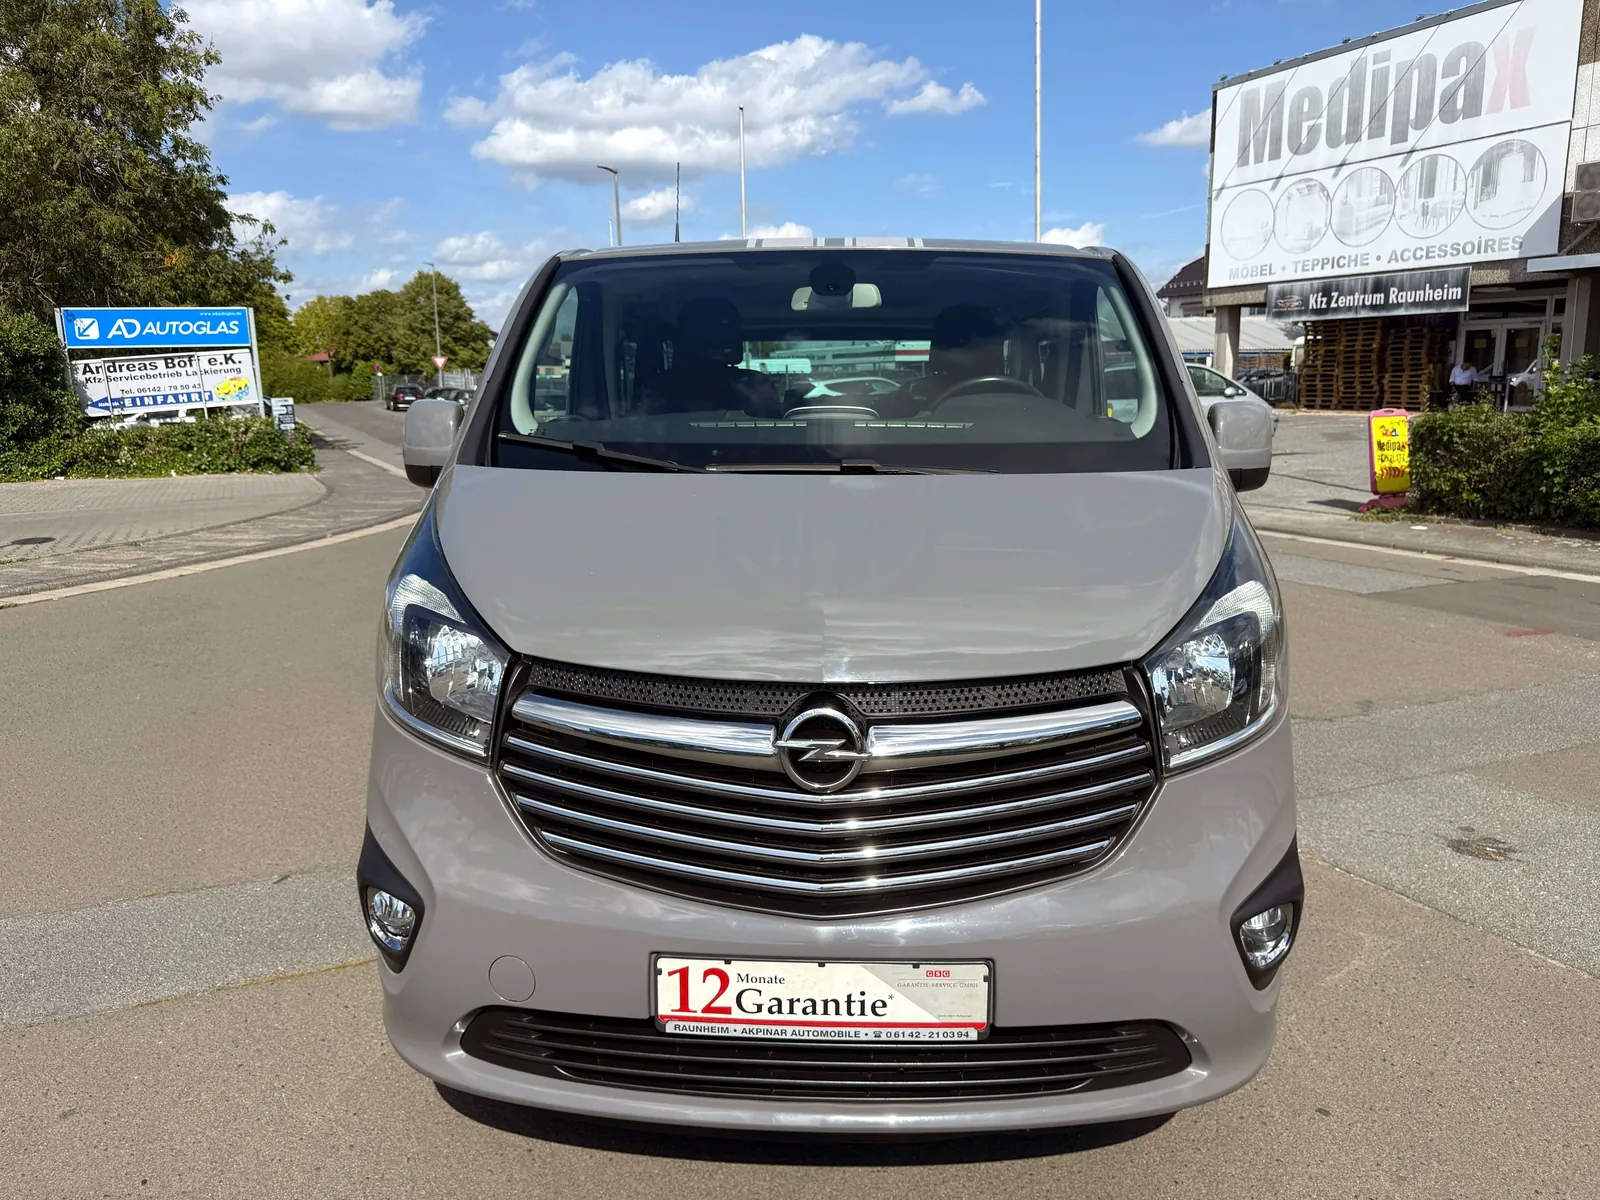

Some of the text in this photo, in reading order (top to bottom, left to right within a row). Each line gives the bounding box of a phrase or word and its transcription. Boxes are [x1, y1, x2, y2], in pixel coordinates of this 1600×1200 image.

[1237, 25, 1537, 168] Medipax
[1229, 263, 1276, 280] MÖBEL
[1292, 253, 1370, 273] TEPPICHE
[1309, 283, 1462, 310] Kfz Zentrum Raunheim
[142, 320, 240, 336] AUTOGLAS
[207, 353, 242, 366] e.K.
[136, 386, 161, 394] 06142
[123, 391, 211, 407] EINFAHRT
[736, 972, 786, 985] Monate
[667, 966, 732, 1015] 12
[674, 1023, 730, 1034] RAUNHEIM
[741, 1027, 788, 1037] AKPINAR
[790, 1029, 861, 1039] AUTOMOBILE
